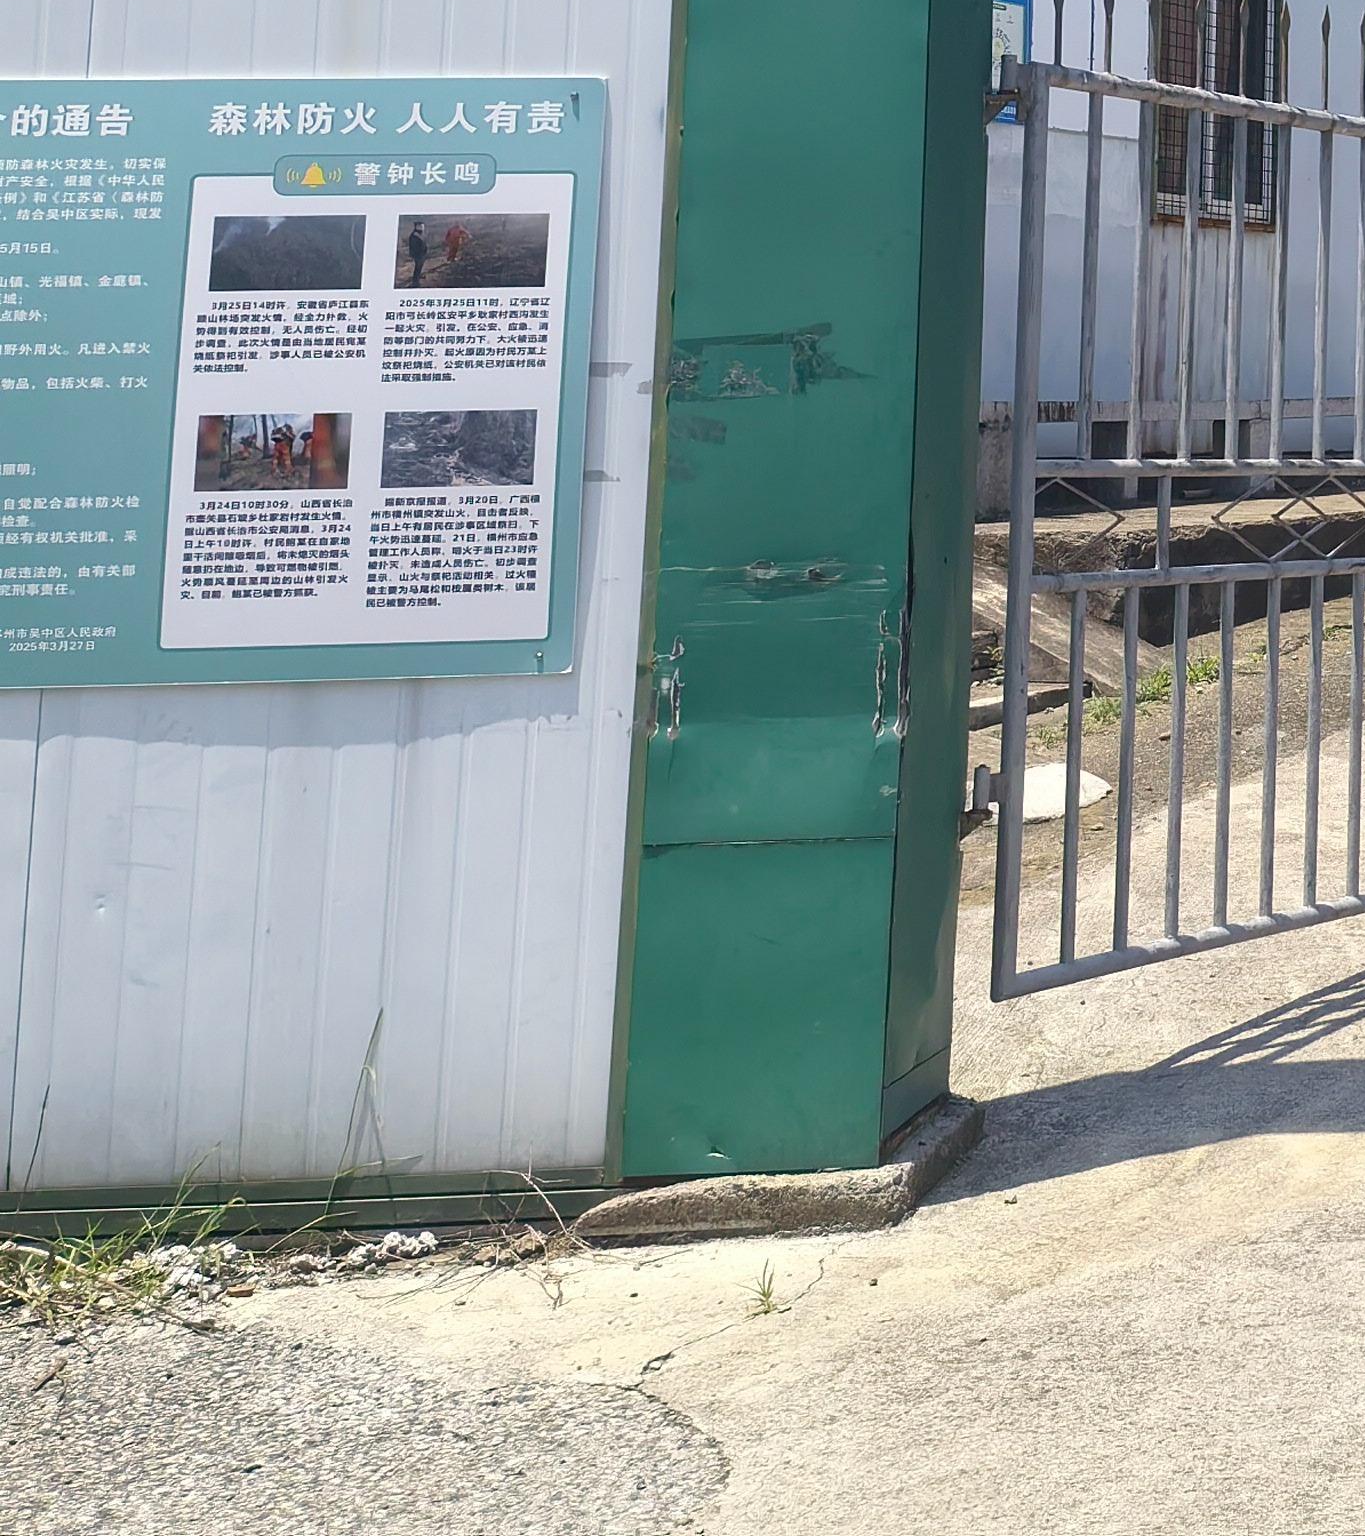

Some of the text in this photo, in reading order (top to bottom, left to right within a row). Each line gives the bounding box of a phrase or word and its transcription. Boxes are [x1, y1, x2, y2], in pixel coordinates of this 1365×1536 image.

[0, 103, 134, 138] 的通告
[208, 100, 565, 136] 森林防火 人人有责
[354, 161, 481, 186] 警钟长鸣
[0, 191, 164, 205] 例》和《江苏省〈森林防
[0, 207, 162, 221] ，结合吴中区实际，现发
[0, 293, 24, 306] 域；
[0, 342, 151, 357] 野外用火。凡进入禁火
[0, 376, 149, 390] 物品，包括火柴、打火
[0, 463, 37, 476] 照明；
[0, 565, 136, 579] 成违法的，由有关部
[9, 640, 96, 653] 2025年3月27日
